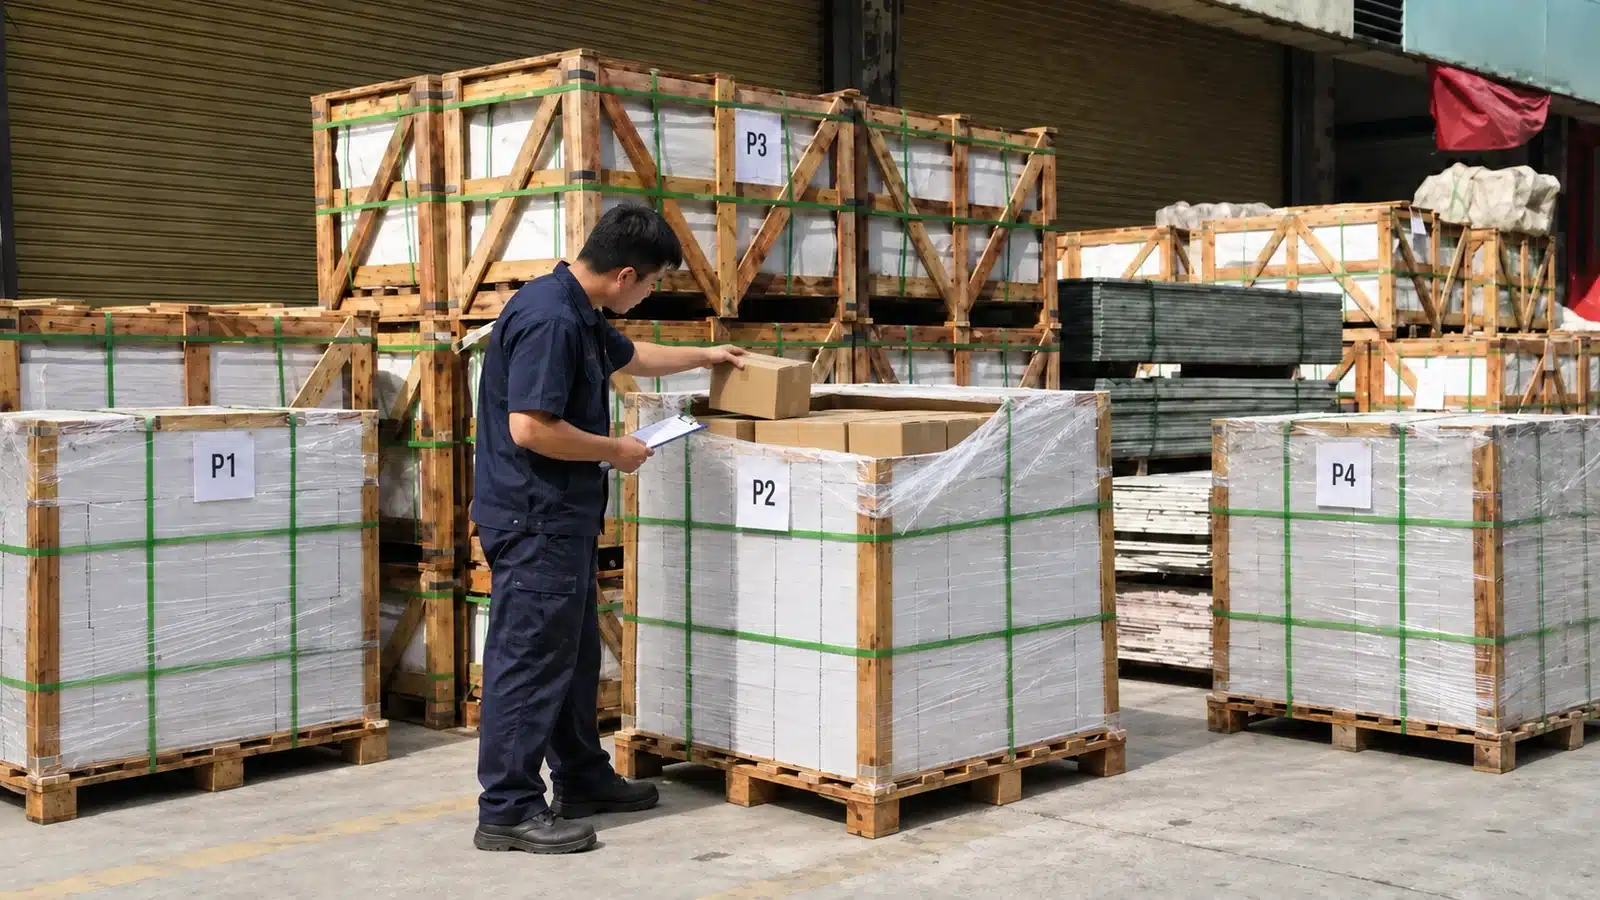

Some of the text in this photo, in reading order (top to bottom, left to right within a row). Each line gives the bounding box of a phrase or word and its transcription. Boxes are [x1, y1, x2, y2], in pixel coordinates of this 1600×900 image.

[747, 131, 767, 157] P3
[211, 453, 235, 479] P1
[1332, 462, 1356, 487] P4
[753, 479, 776, 507] P2
